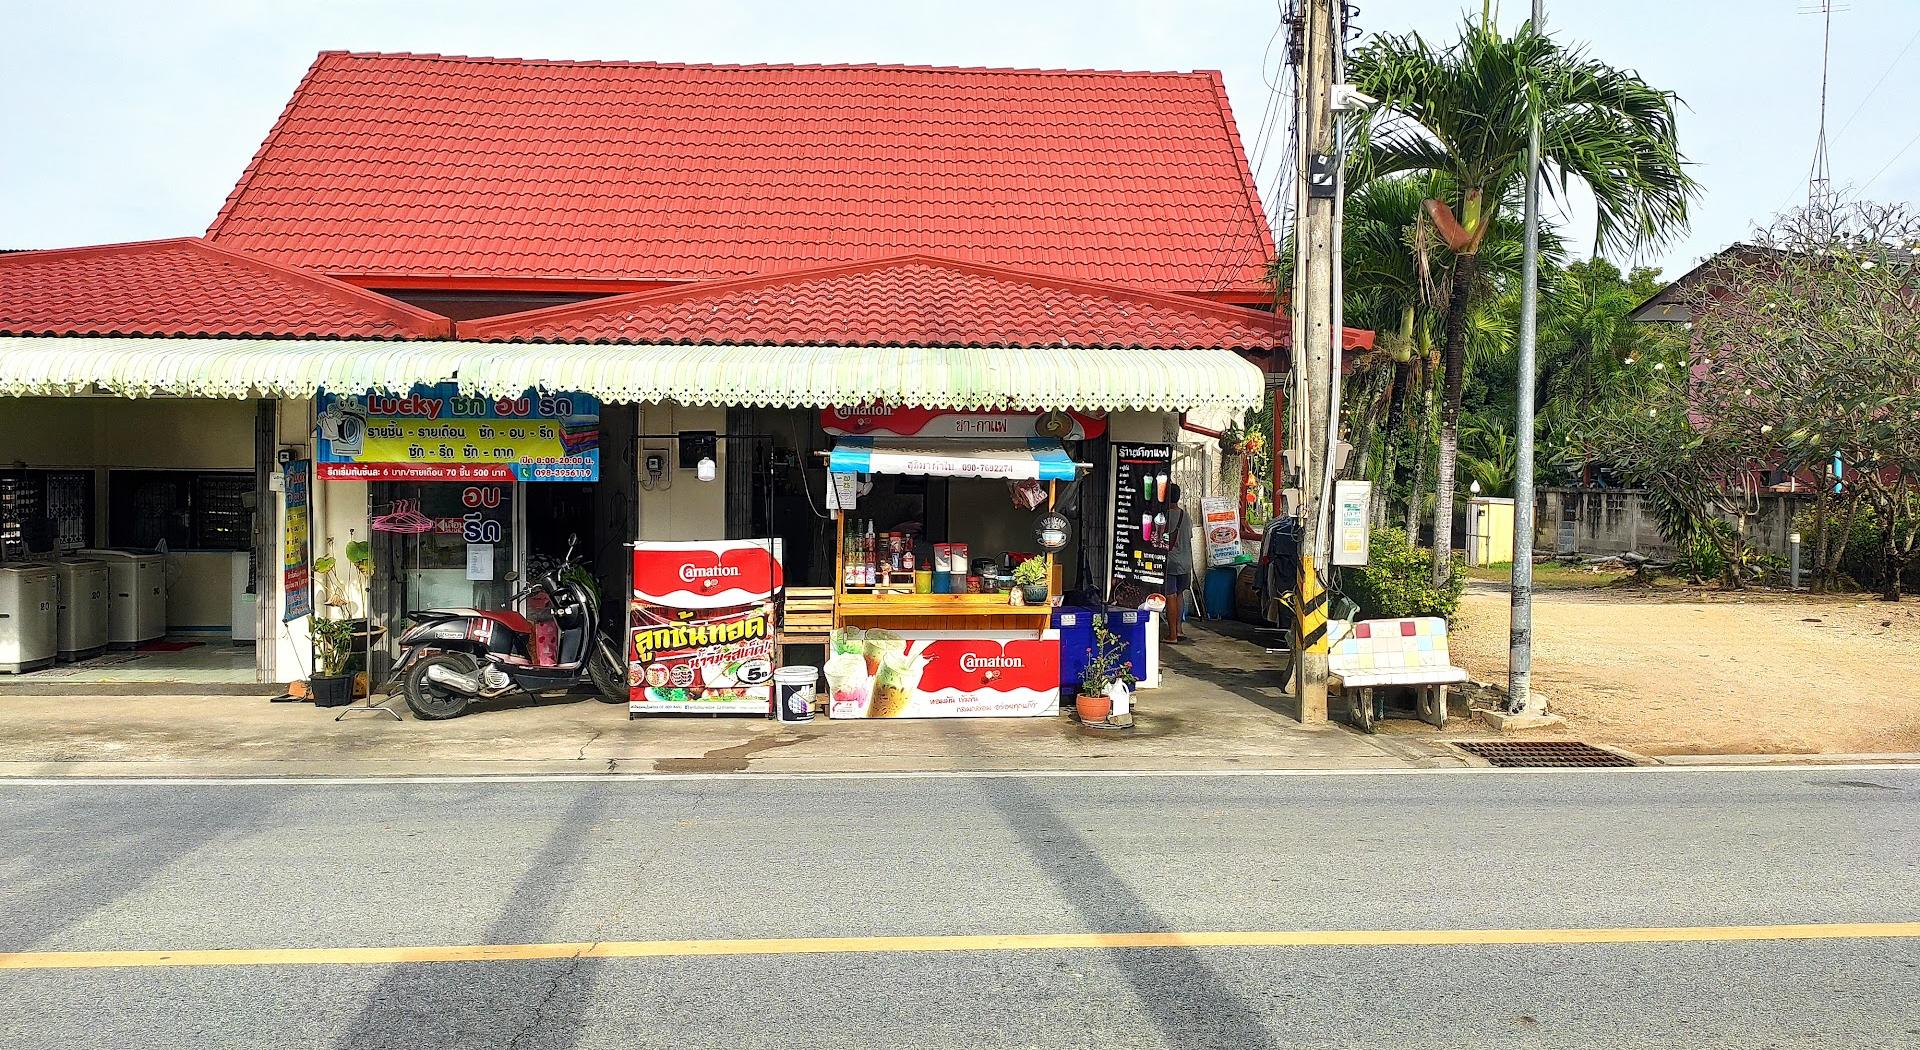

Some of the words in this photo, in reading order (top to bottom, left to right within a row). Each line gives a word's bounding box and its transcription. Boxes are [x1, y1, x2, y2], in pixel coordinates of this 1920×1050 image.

[368, 393, 443, 420] Lucky
[494, 398, 531, 416] อบ
[367, 420, 404, 438] รายชิ้น
[417, 424, 466, 438] รายเดือน
[479, 424, 495, 438] ซัก
[509, 428, 525, 438] อบ
[539, 424, 555, 438] รีด
[408, 443, 425, 458] ซัก
[438, 443, 454, 458] รีด
[463, 443, 479, 458] ซัก
[493, 448, 514, 459] ตาก
[536, 456, 583, 464] 8:00-20:00
[383, 468, 389, 477] 6
[446, 468, 457, 477] 70
[473, 468, 488, 477] 500
[491, 468, 506, 477] บาท
[534, 468, 592, 477] 098-3956119
[462, 486, 501, 508] อบ
[463, 511, 501, 543] รีด
[678, 563, 741, 583] Carnation
[634, 611, 765, 662] ลูกชิ้นทอด
[959, 652, 1024, 673] Carnation
